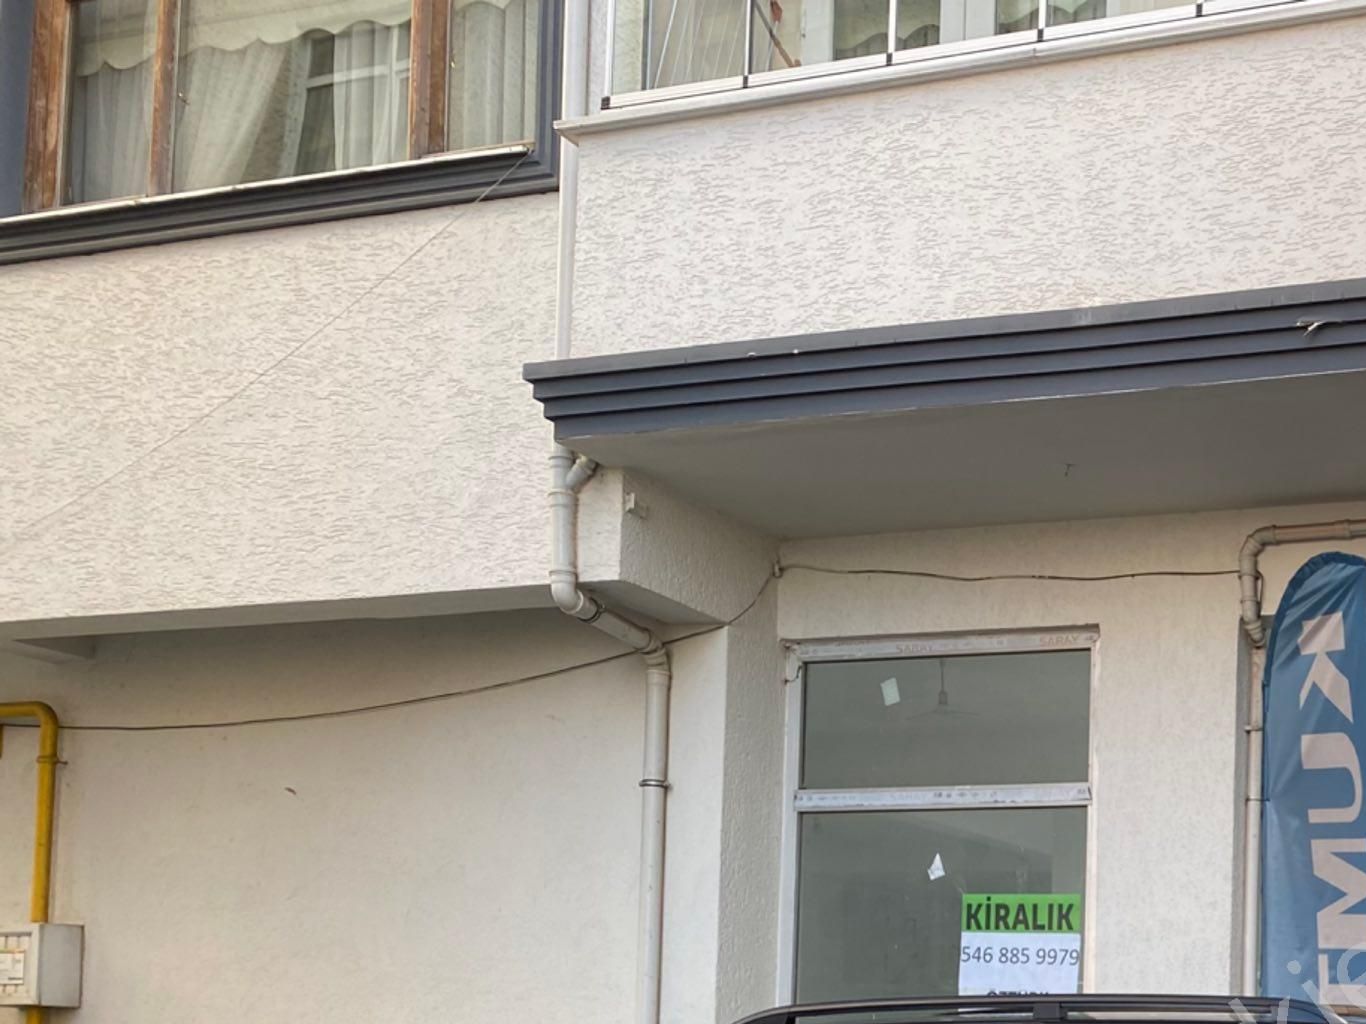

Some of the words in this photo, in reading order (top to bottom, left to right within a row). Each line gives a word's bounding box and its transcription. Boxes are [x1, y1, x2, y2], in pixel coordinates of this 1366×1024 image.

[1039, 634, 1079, 647] SARAY
[965, 896, 1074, 930] KİRALIK
[961, 946, 993, 963] 546
[998, 947, 1030, 964] 885
[1035, 948, 1080, 966] 9979
